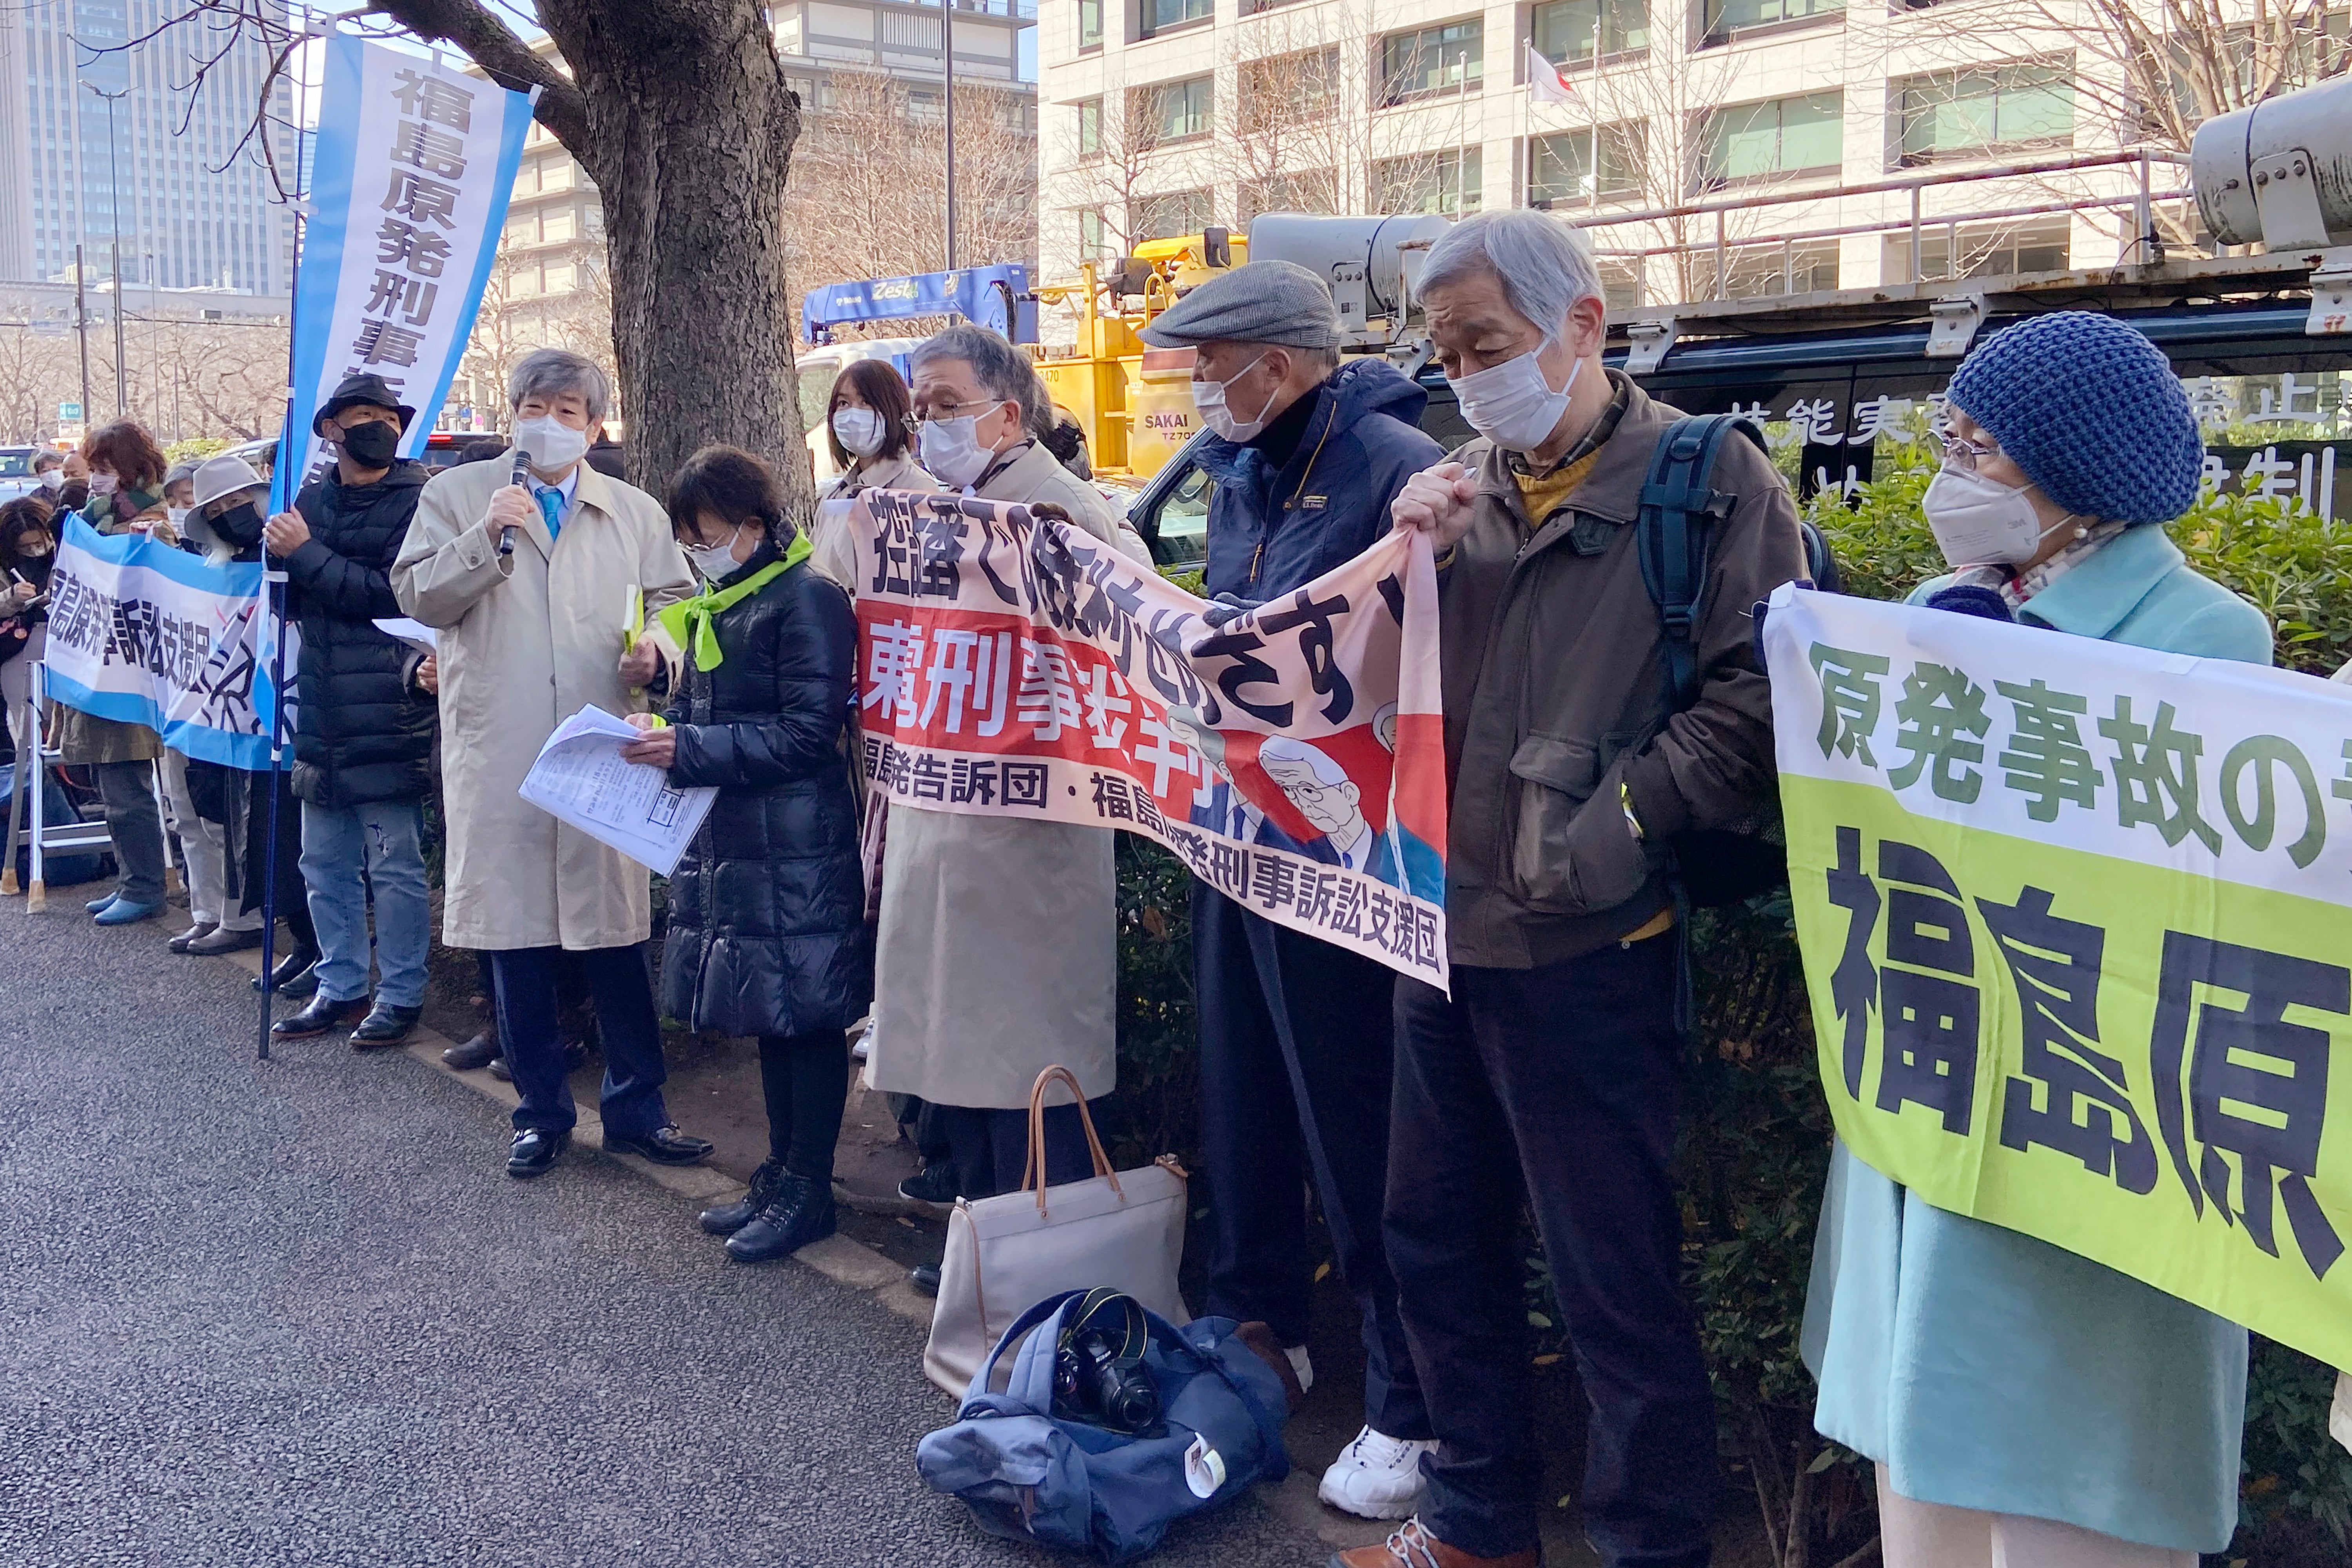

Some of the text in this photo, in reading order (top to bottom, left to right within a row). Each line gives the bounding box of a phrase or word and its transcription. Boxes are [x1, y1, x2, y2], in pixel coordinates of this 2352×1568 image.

[342, 67, 475, 397] 福島原発刑事
[871, 279, 911, 301] Zest
[1145, 414, 1188, 429] SAKAI
[1809, 641, 2352, 869] 原発事故の
[1826, 826, 2351, 1282] 福島原
